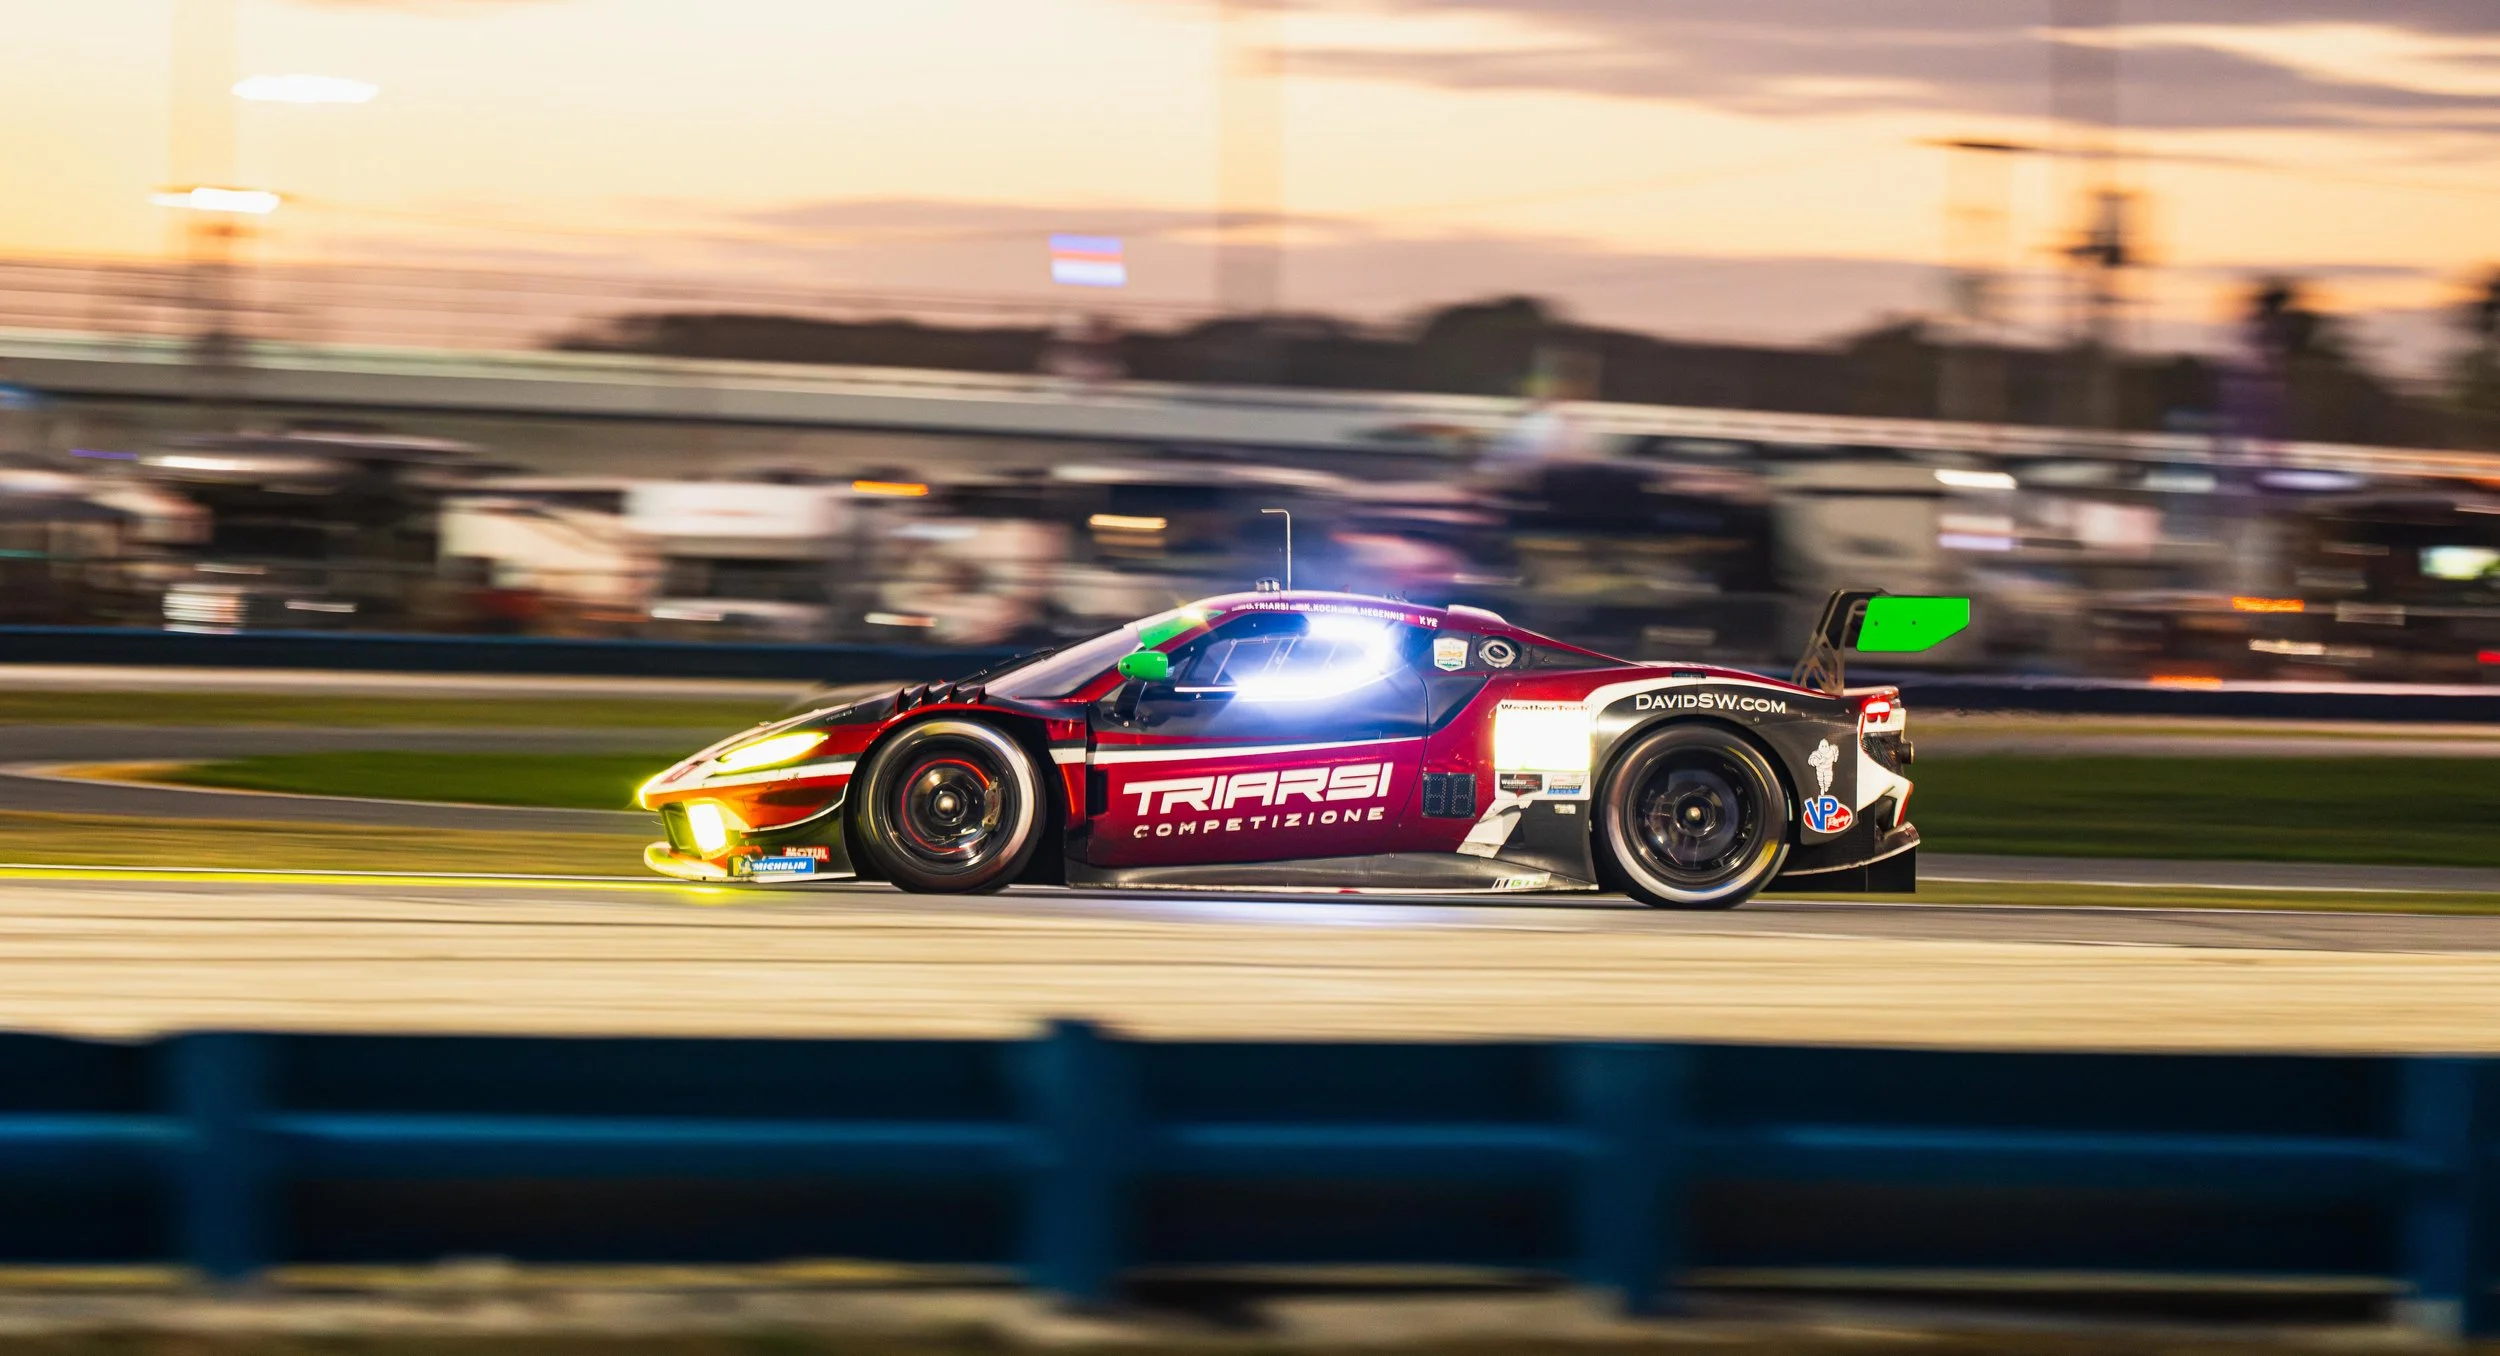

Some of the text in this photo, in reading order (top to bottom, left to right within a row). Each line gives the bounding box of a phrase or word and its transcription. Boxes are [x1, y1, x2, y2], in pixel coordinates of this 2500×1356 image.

[1122, 762, 1394, 816] TRIARSI
[1133, 807, 1385, 838] COMPETIZIONE
[1804, 795, 1839, 832] VP
[752, 861, 807, 871] MICHELIN
[785, 847, 827, 860] MOTUL
